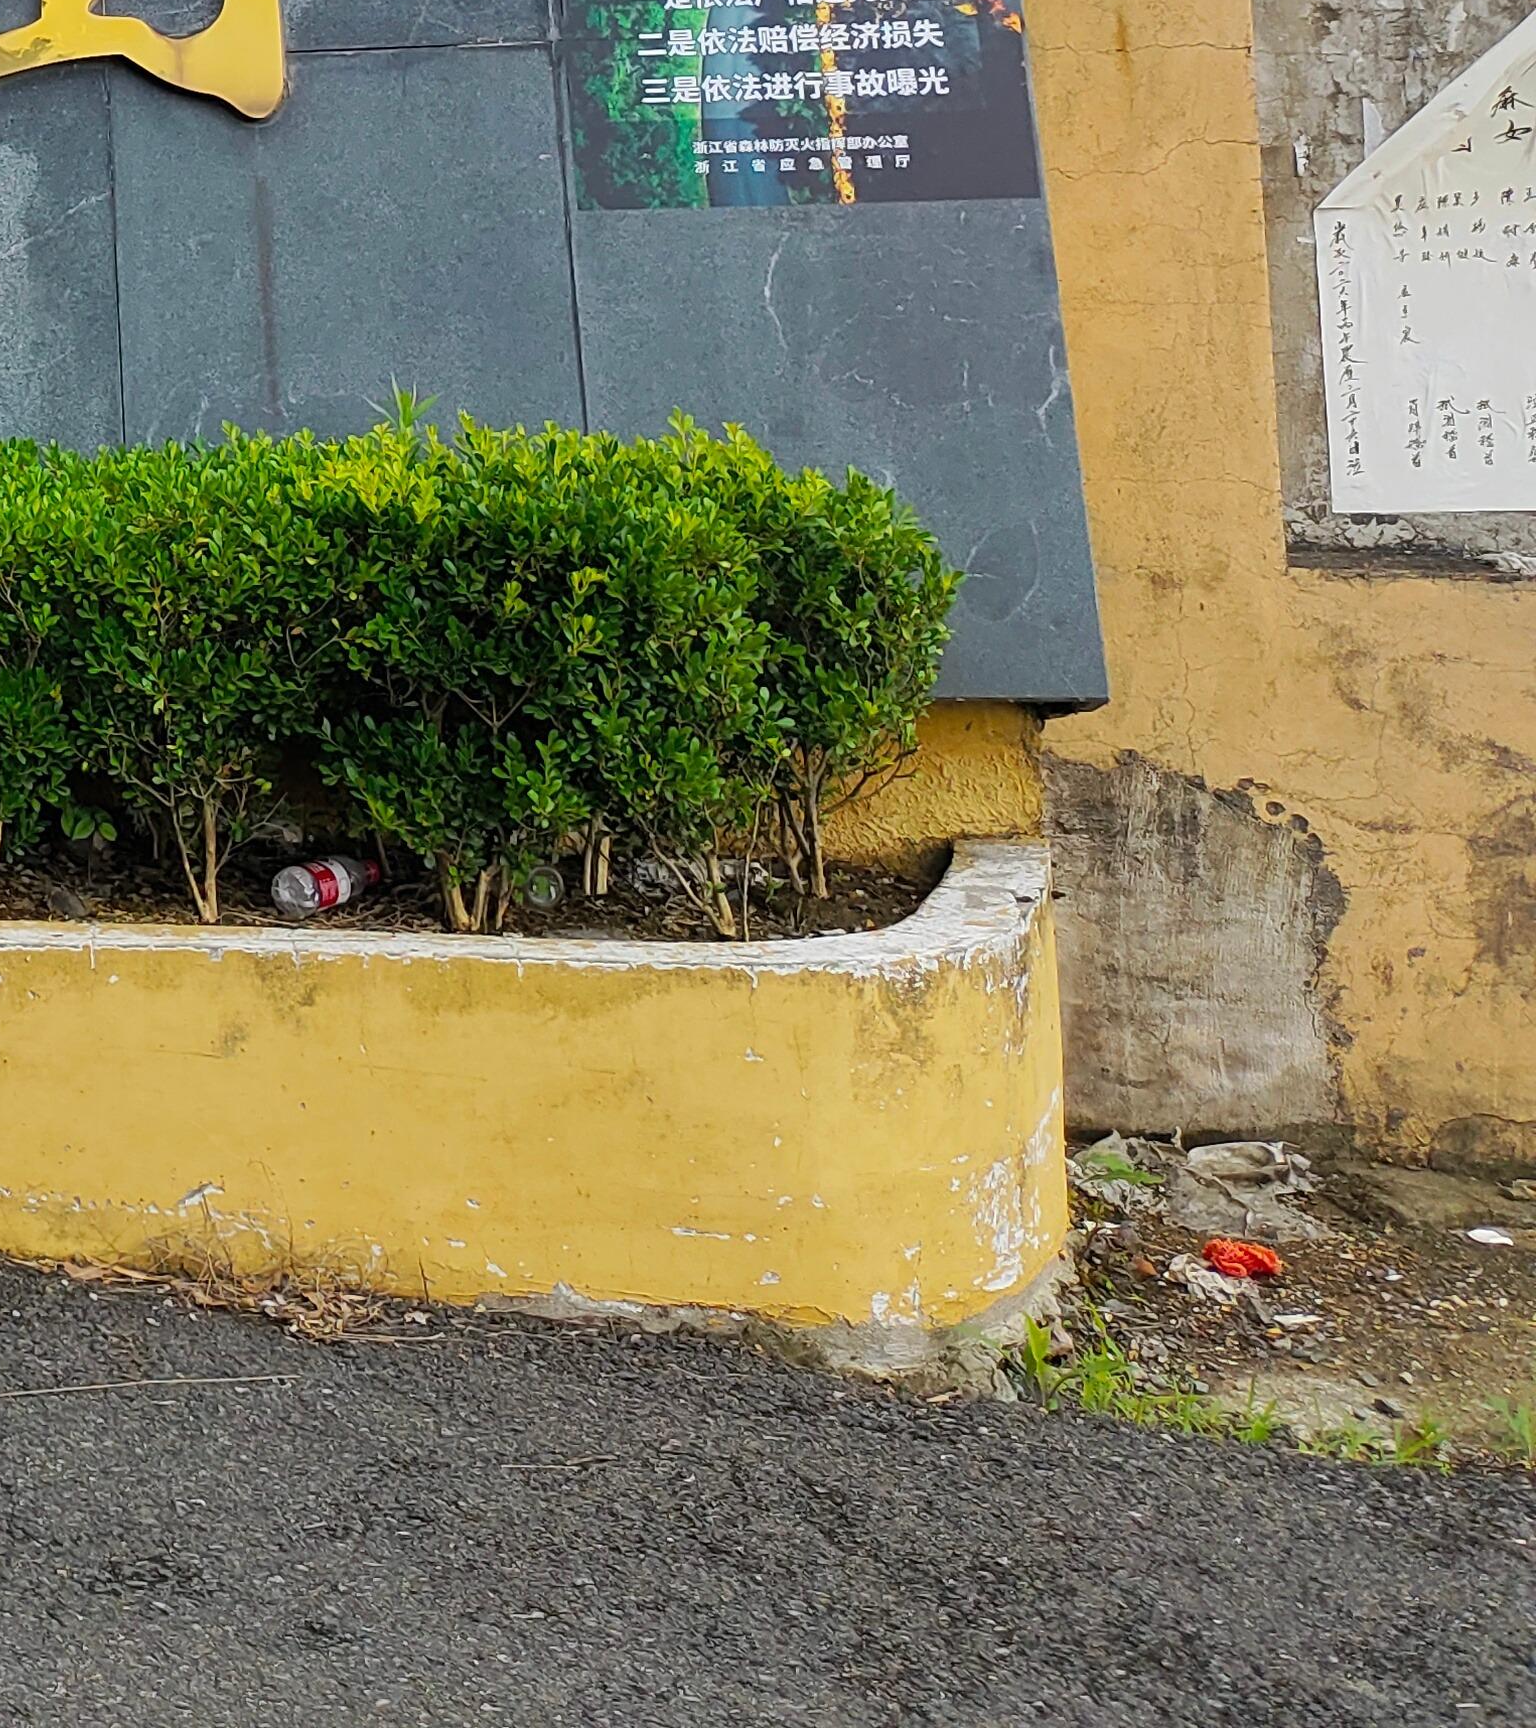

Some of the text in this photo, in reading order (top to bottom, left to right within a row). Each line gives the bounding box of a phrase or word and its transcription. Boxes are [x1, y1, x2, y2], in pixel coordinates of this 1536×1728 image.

[637, 20, 944, 58] 二是依法赔偿经济损失
[641, 65, 949, 106] 三是依法进行事故曝光
[692, 135, 910, 155] 浙江省森林防灭火指挥部办公室
